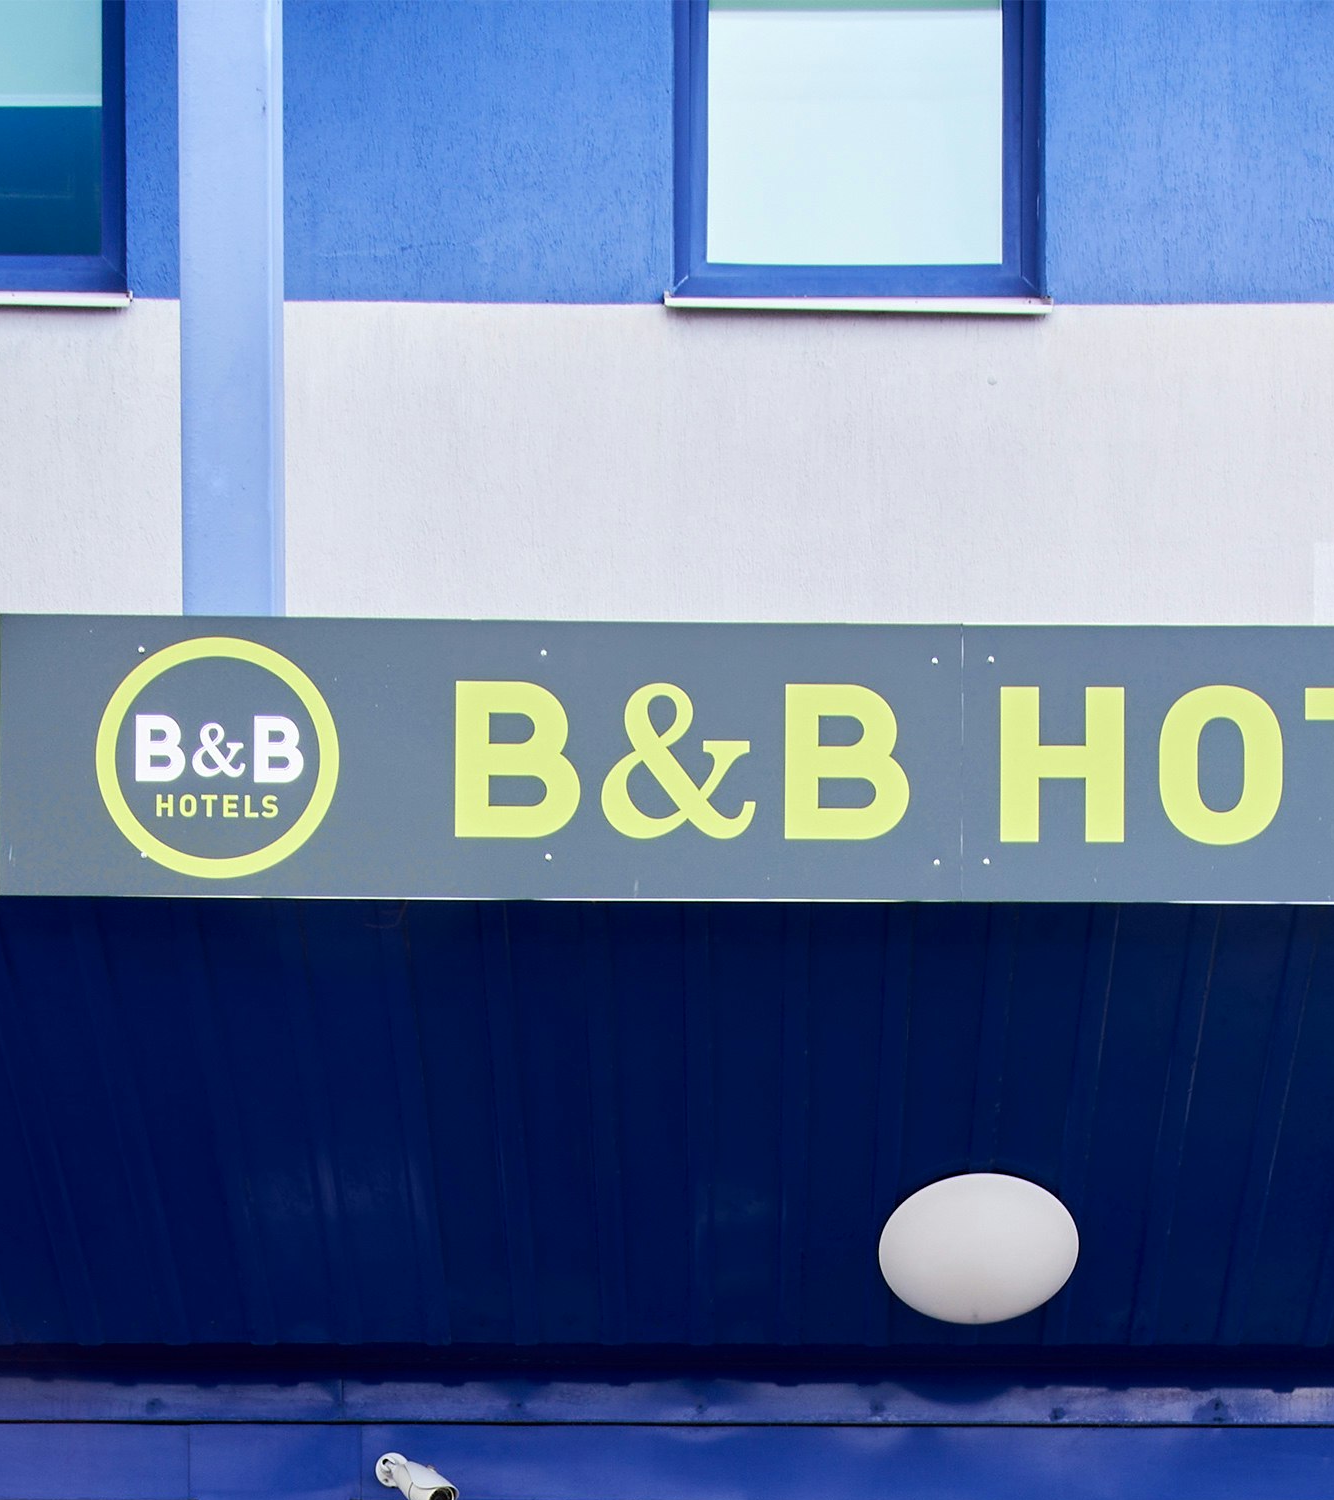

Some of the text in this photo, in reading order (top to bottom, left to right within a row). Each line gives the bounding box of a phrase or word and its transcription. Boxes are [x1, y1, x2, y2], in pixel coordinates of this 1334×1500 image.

[135, 714, 305, 785] B&B
[455, 680, 910, 840] B&B
[155, 794, 280, 819] HOTELS
